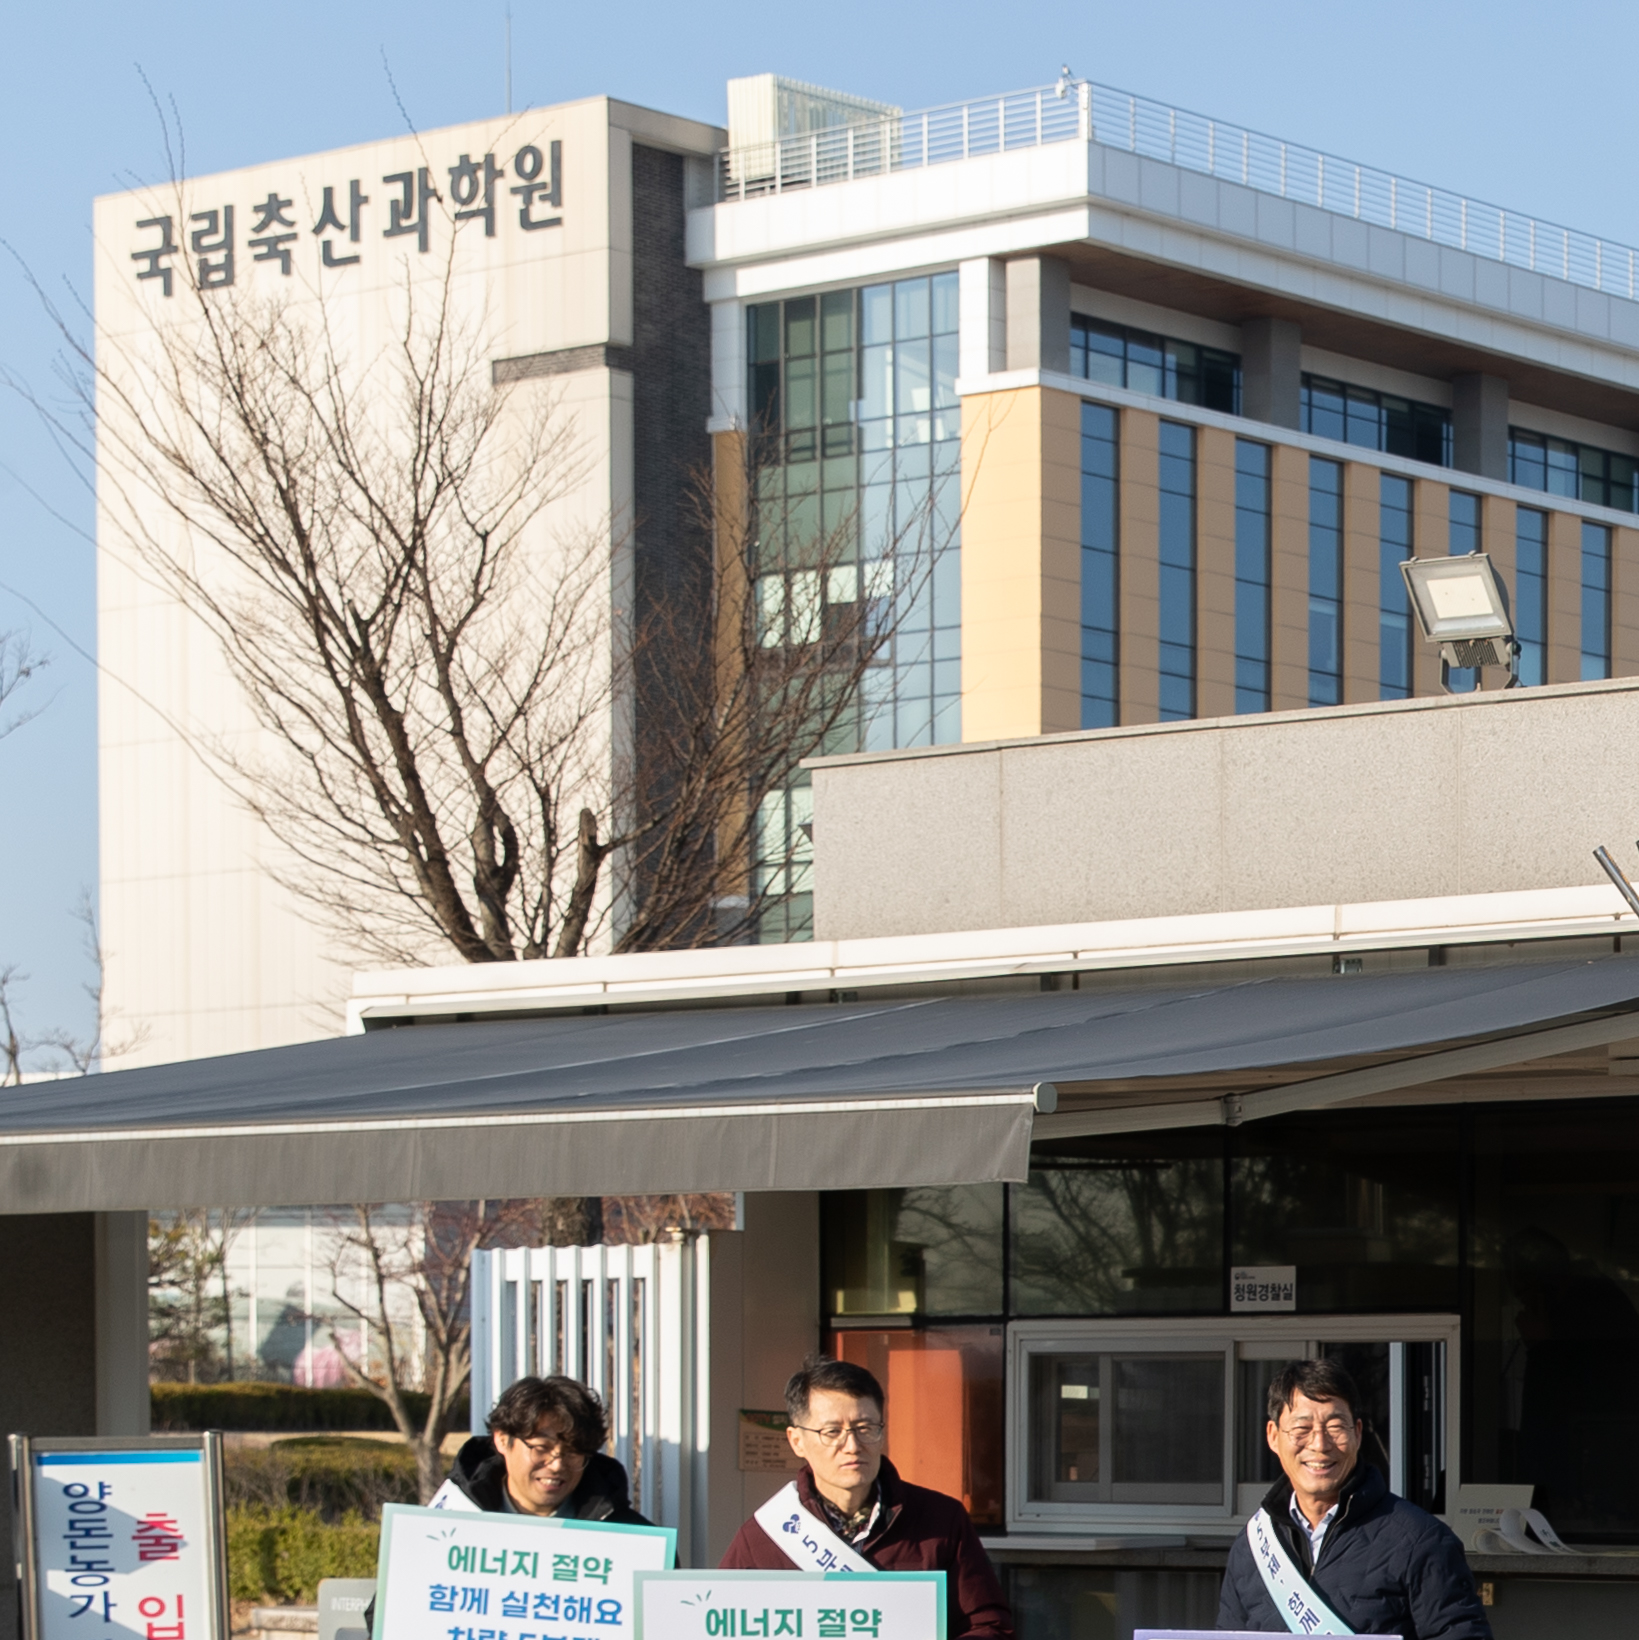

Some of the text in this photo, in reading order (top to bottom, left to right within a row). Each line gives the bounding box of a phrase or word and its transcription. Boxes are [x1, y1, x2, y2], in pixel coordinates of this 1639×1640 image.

[130, 139, 565, 298] 국립축산과학원
[1234, 1283, 1294, 1302] 청원경찰실
[62, 1481, 118, 1624] 양돈농가
[447, 1545, 613, 1585] 에너지 절약
[429, 1583, 623, 1626] 함께 실천해요
[706, 1608, 883, 1638] 에너지 절약
[1287, 1592, 1320, 1634] 함께
